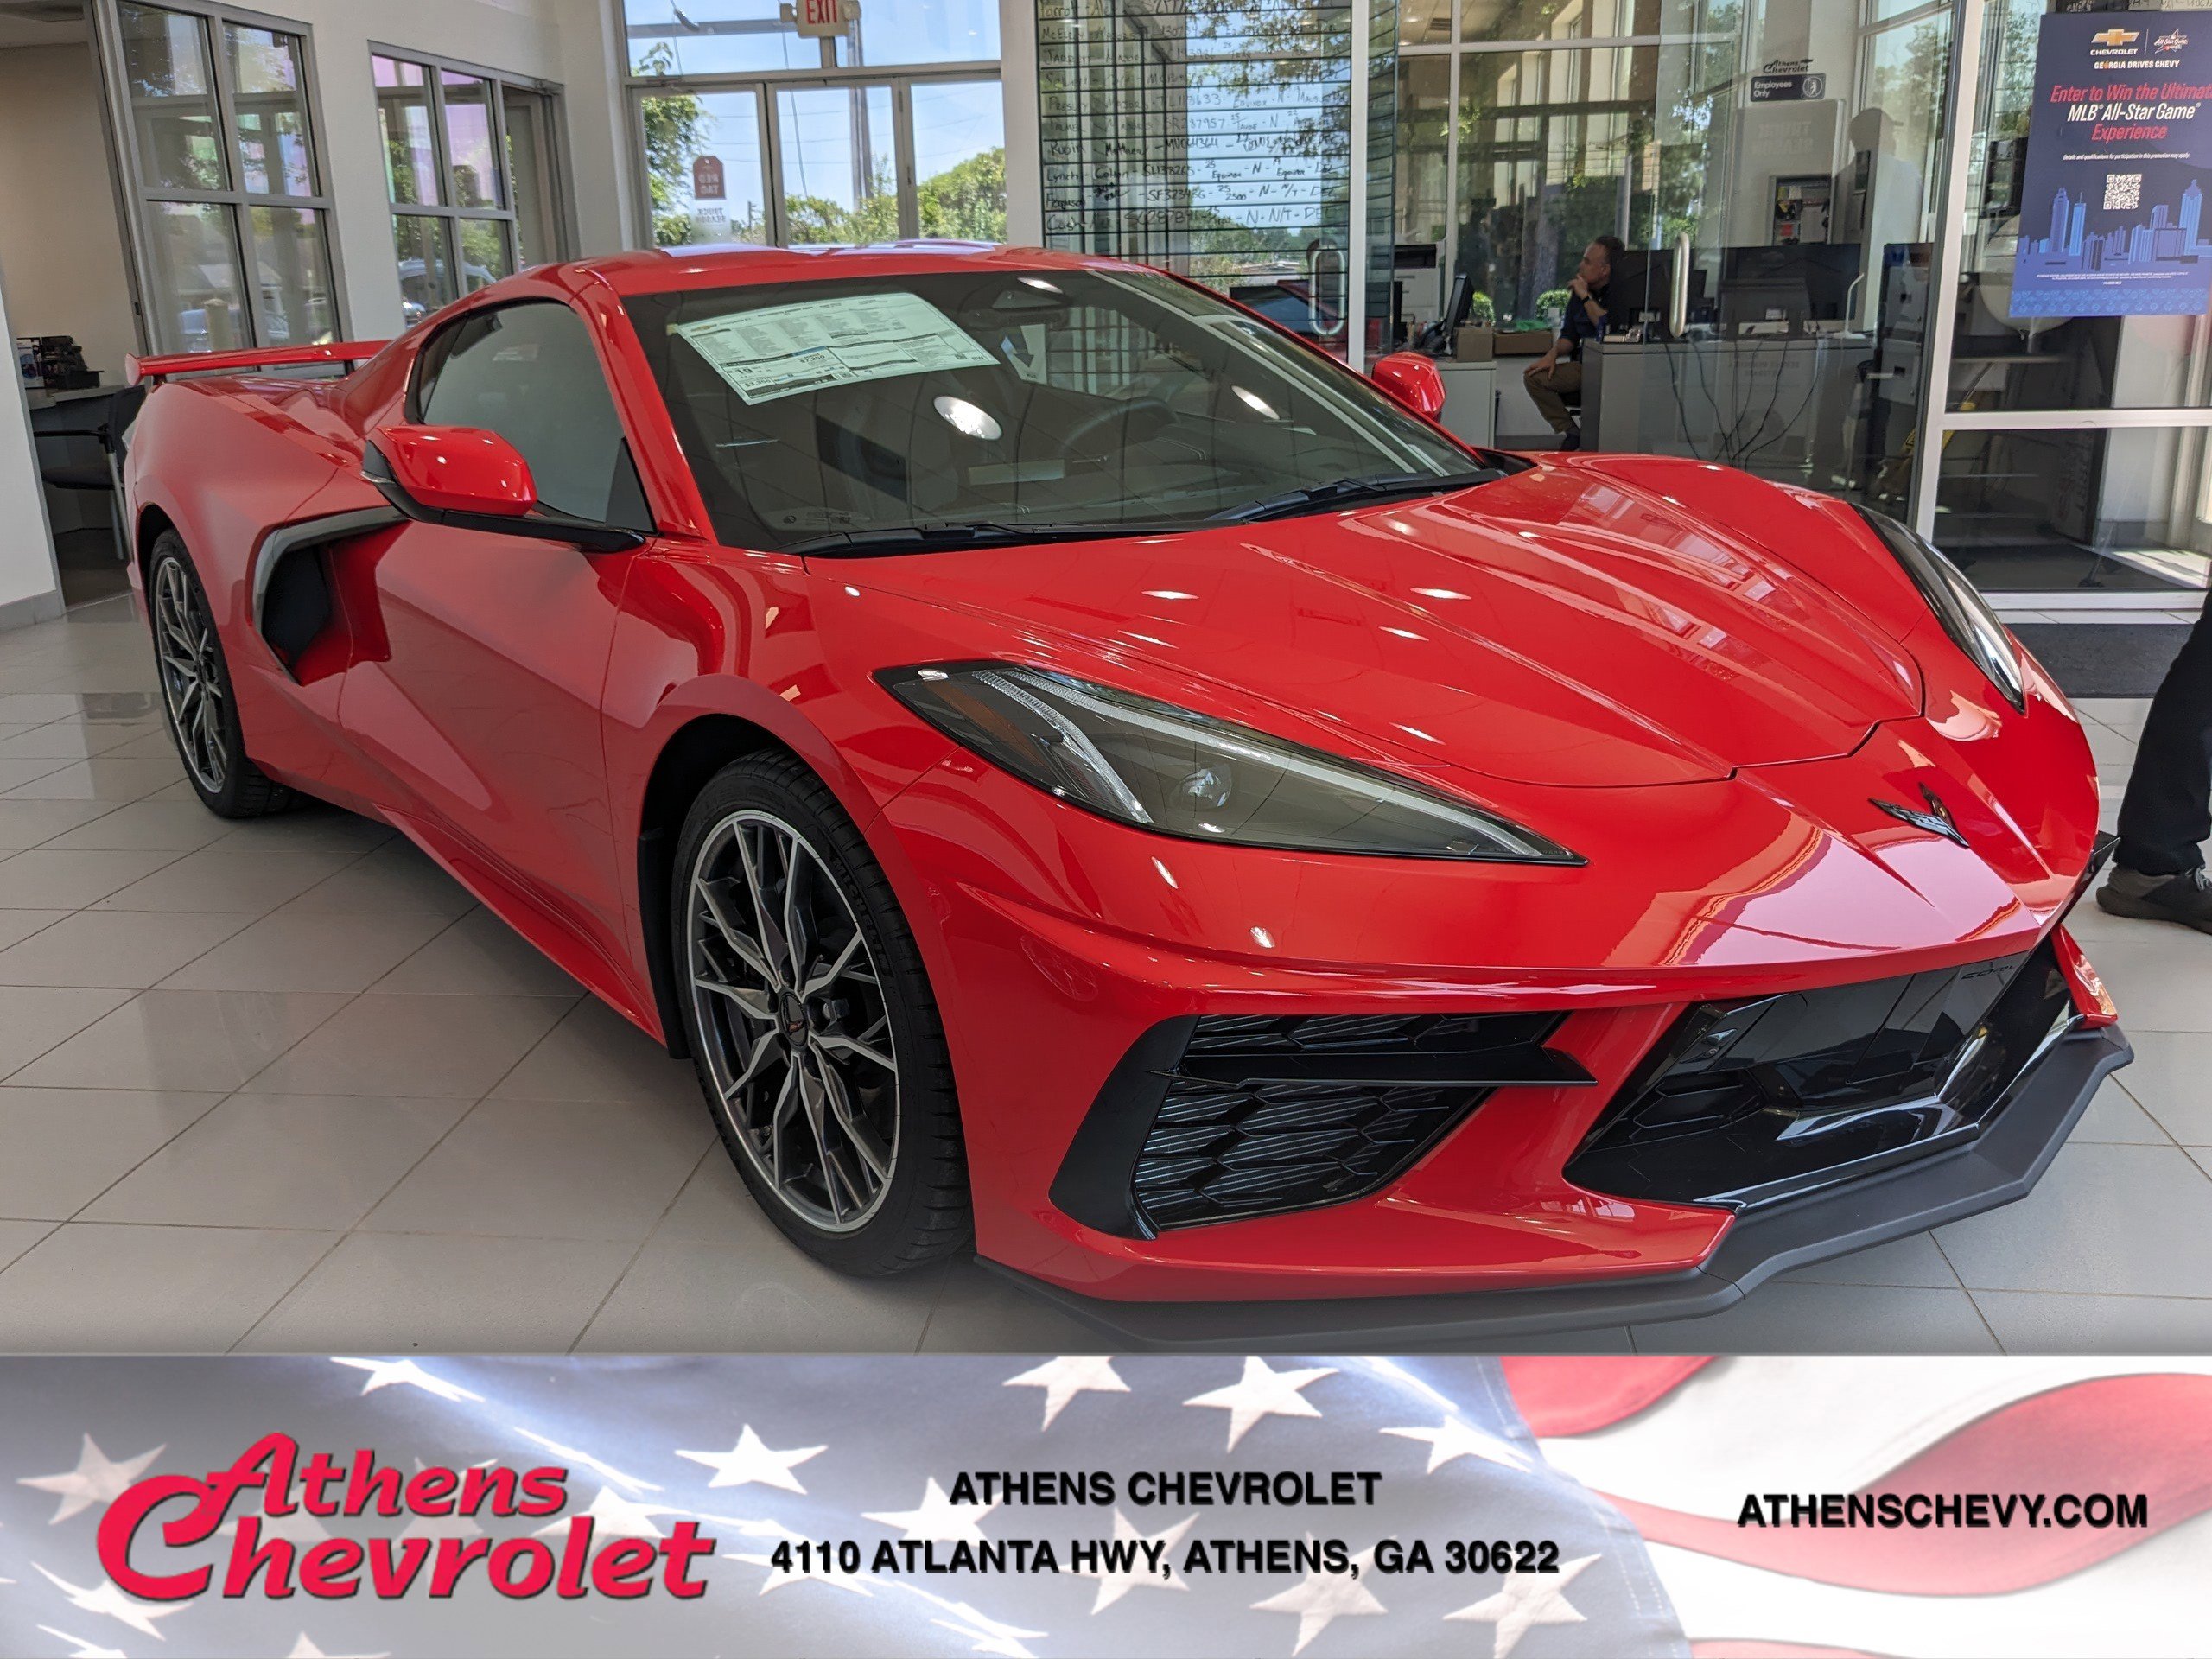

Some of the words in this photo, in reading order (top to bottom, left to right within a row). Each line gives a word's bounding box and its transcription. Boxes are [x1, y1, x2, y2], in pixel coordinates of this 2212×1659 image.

[1763, 63, 1809, 73] Chevrolet
[2050, 85, 2088, 103] Enter
[2089, 86, 2103, 102] to
[2107, 83, 2133, 101] Win
[2135, 82, 2158, 100] the
[2101, 102, 2156, 121] All-Star
[2091, 123, 2169, 144] Experience
